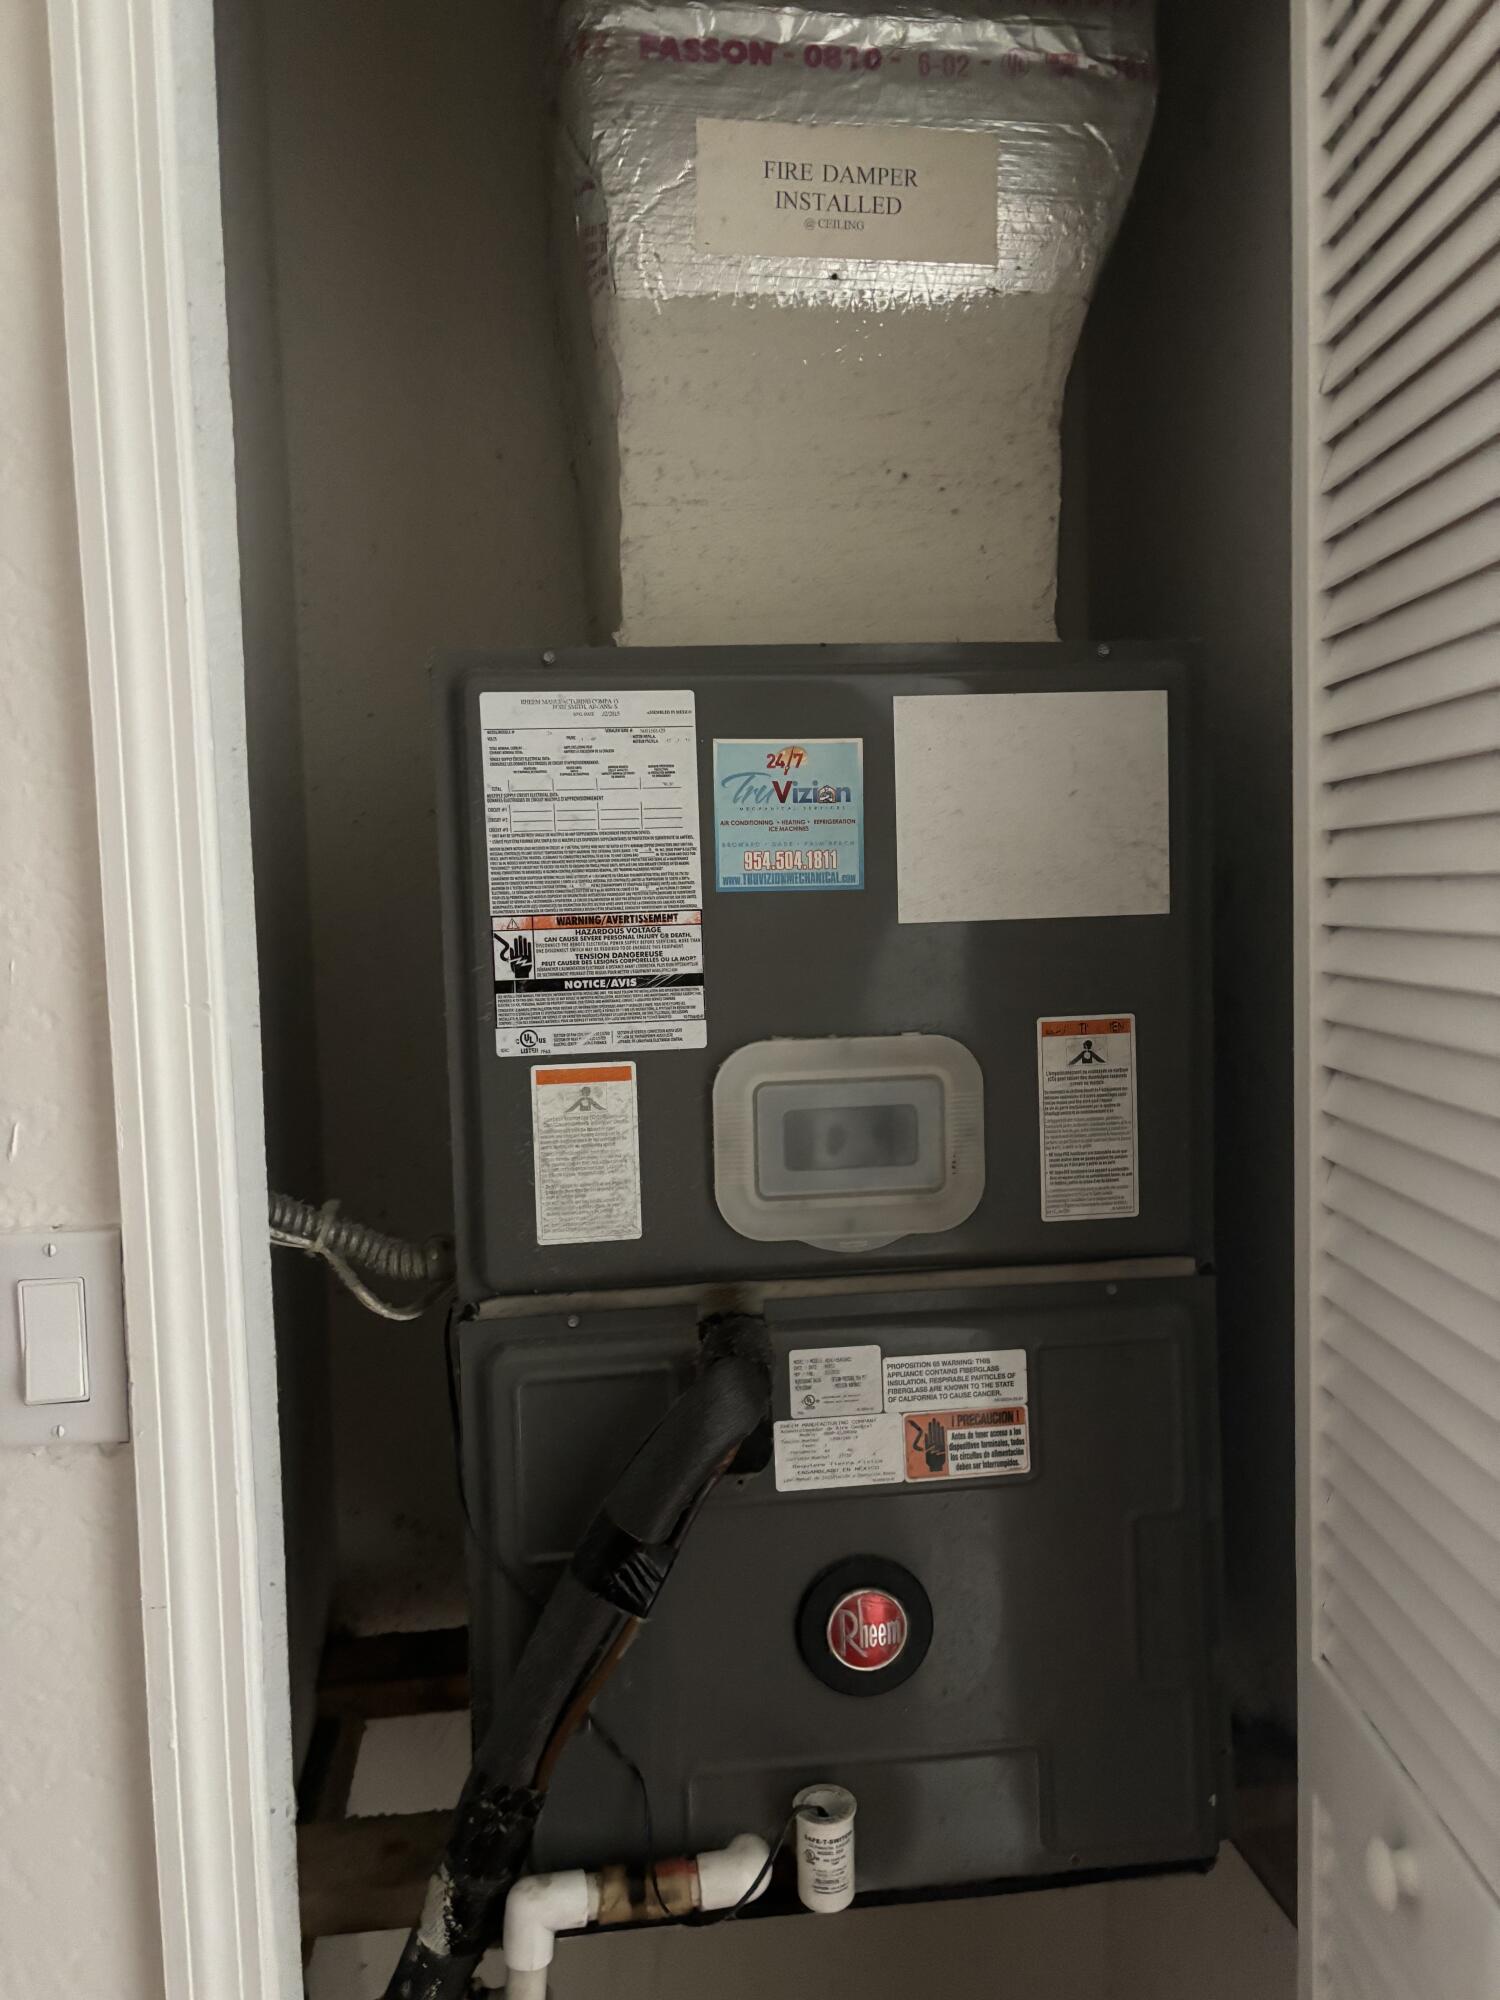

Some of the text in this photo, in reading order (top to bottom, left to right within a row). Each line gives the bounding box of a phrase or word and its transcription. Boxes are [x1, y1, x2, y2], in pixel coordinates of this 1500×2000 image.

[640, 33, 775, 66] FASSON
[763, 160, 918, 188] FIRE DAMPER
[775, 190, 902, 216] INSTALLED
[818, 219, 865, 231] CEILING
[766, 746, 804, 775] 24/7
[743, 850, 838, 871] 954.504.1811
[556, 913, 679, 926] WARNING/AVERTISSEMENT
[575, 926, 662, 936] HAZARDOUS VOLTAGE
[564, 978, 637, 990] NOTICE/AVIS
[886, 1361, 931, 1370] PROPOSITION
[941, 1359, 974, 1367] WARNING:
[887, 1365, 999, 1378] APPLIANCE CONTAINS FIBERGLASS
[929, 1375, 968, 1384] RESPIRABLE
[970, 1373, 1006, 1381] PARTICLES
[888, 1386, 927, 1395] FIBERGLASS
[888, 1395, 896, 1403] OF
[898, 1394, 937, 1402] CALIFORNIA
[949, 1391, 971, 1399] CAUSE
[972, 1390, 1002, 1398] CANCER.
[952, 1432, 966, 1440] Antes
[975, 1431, 988, 1439] tener
[990, 1430, 1007, 1438] acceso
[1013, 1428, 1021, 1436] los
[1011, 1438, 1024, 1446] todos
[950, 1452, 958, 1461] los
[960, 1451, 982, 1460] circuitos
[984, 1450, 990, 1458] de
[956, 1463, 971, 1471] deben
[839, 1597, 902, 1659] Rheem
